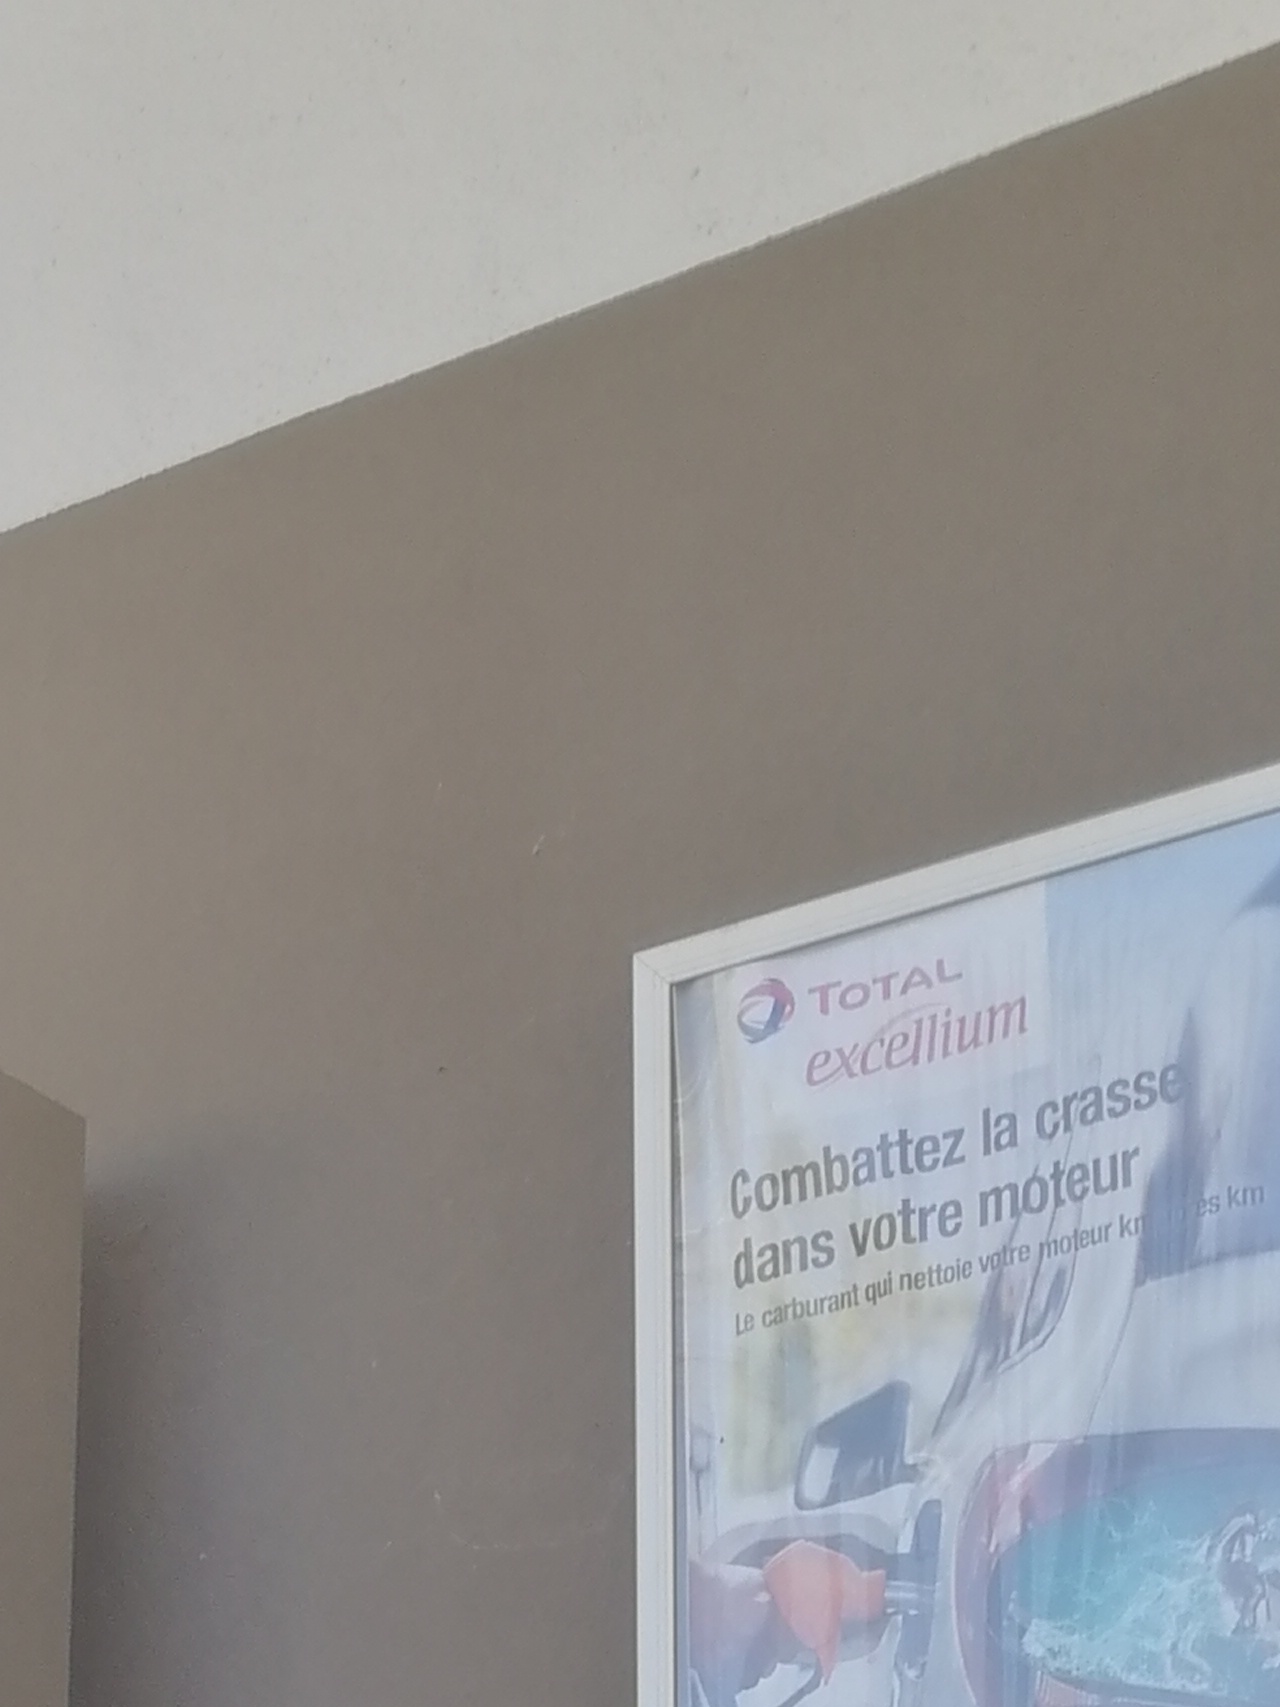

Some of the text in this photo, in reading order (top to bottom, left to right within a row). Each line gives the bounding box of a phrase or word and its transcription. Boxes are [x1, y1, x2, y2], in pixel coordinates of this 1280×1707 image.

[805, 995, 1029, 1087] excellium
[808, 958, 963, 1016] TOTAL
[730, 1063, 1184, 1219] Combattez la crasse
[733, 1146, 1140, 1289] dans votre moteur
[735, 1312, 755, 1336] Le
[761, 1282, 860, 1328] carburant
[865, 1271, 893, 1306] qui
[899, 1258, 973, 1292] nettoie
[978, 1241, 1031, 1274] votre
[1039, 1221, 1113, 1259] moteur
[1226, 1184, 1266, 1210] km
